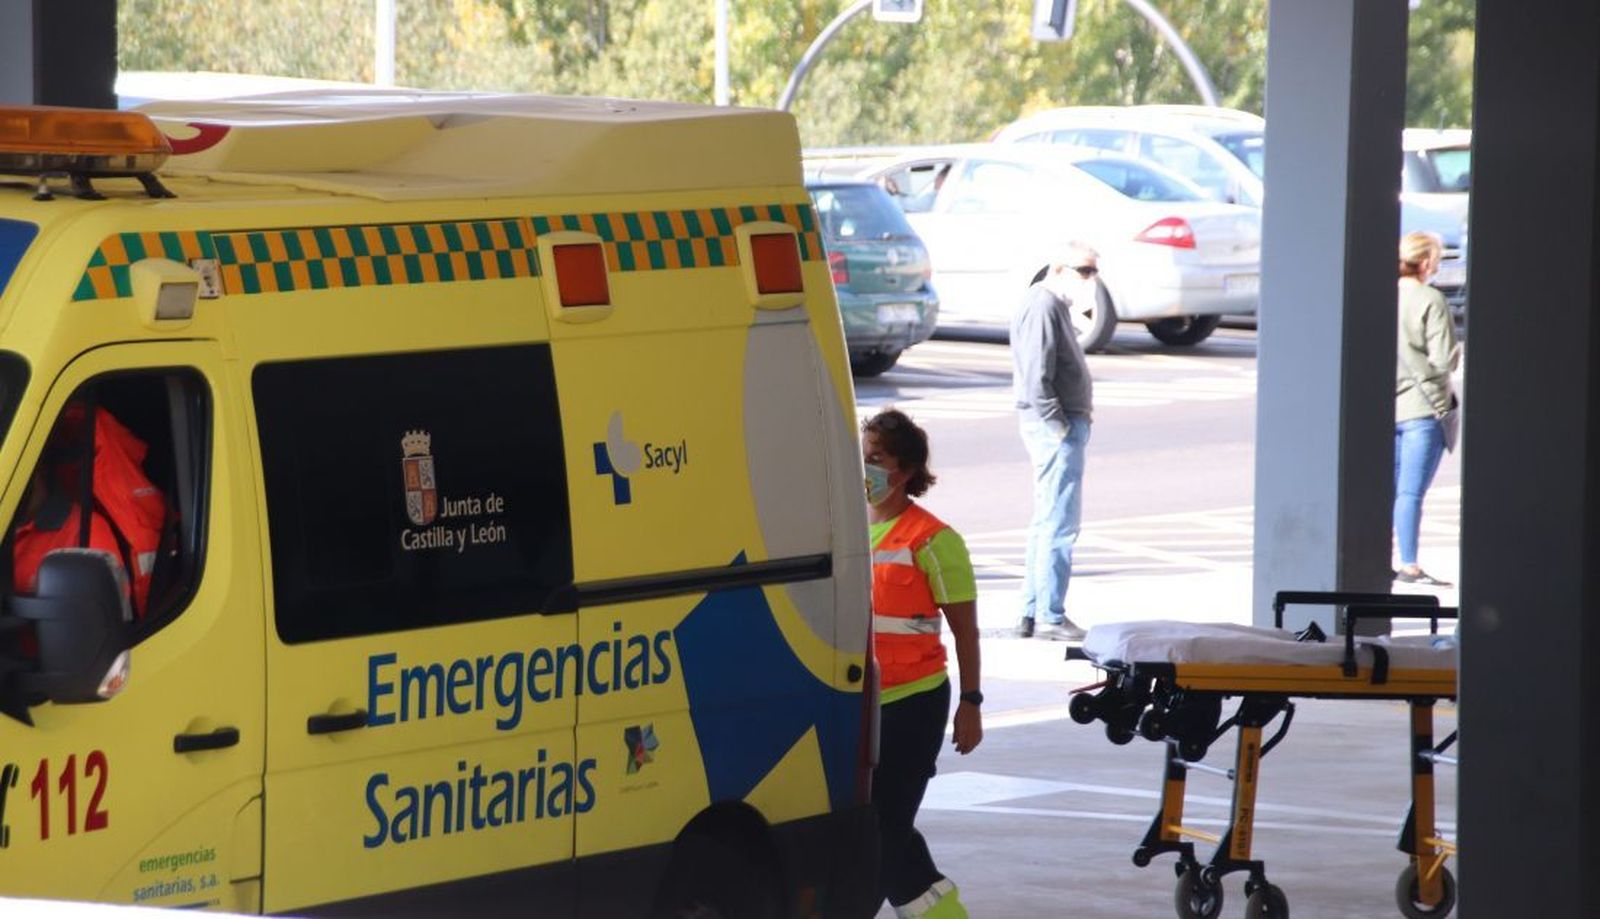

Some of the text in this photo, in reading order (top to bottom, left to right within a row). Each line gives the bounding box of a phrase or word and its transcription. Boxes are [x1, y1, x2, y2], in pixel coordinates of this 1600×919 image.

[644, 439, 688, 474] Sacyl
[440, 492, 504, 518] Junta de
[401, 520, 506, 553] Castilla y León
[367, 621, 672, 731] Emergencias
[31, 749, 109, 841] 112
[363, 749, 597, 849] Sanitarias
[138, 846, 216, 873] emergencias
[133, 873, 196, 902] sanitarias,
[199, 873, 221, 890] s.a.
